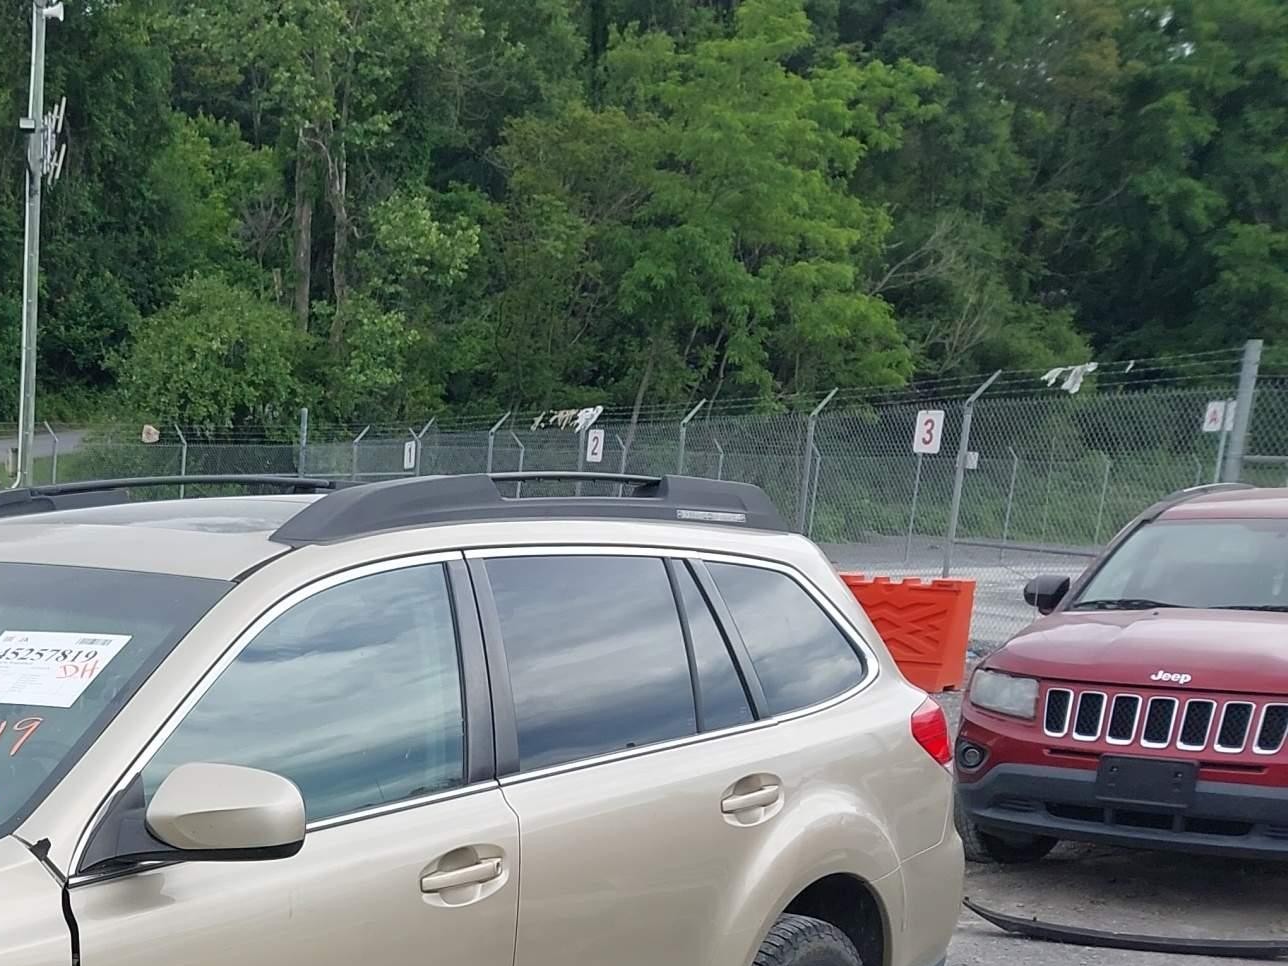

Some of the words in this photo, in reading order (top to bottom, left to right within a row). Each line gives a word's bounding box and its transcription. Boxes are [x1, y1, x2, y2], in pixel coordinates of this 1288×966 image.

[922, 419, 935, 445] 3
[591, 436, 600, 456] 2
[1150, 670, 1192, 685] Jeep
